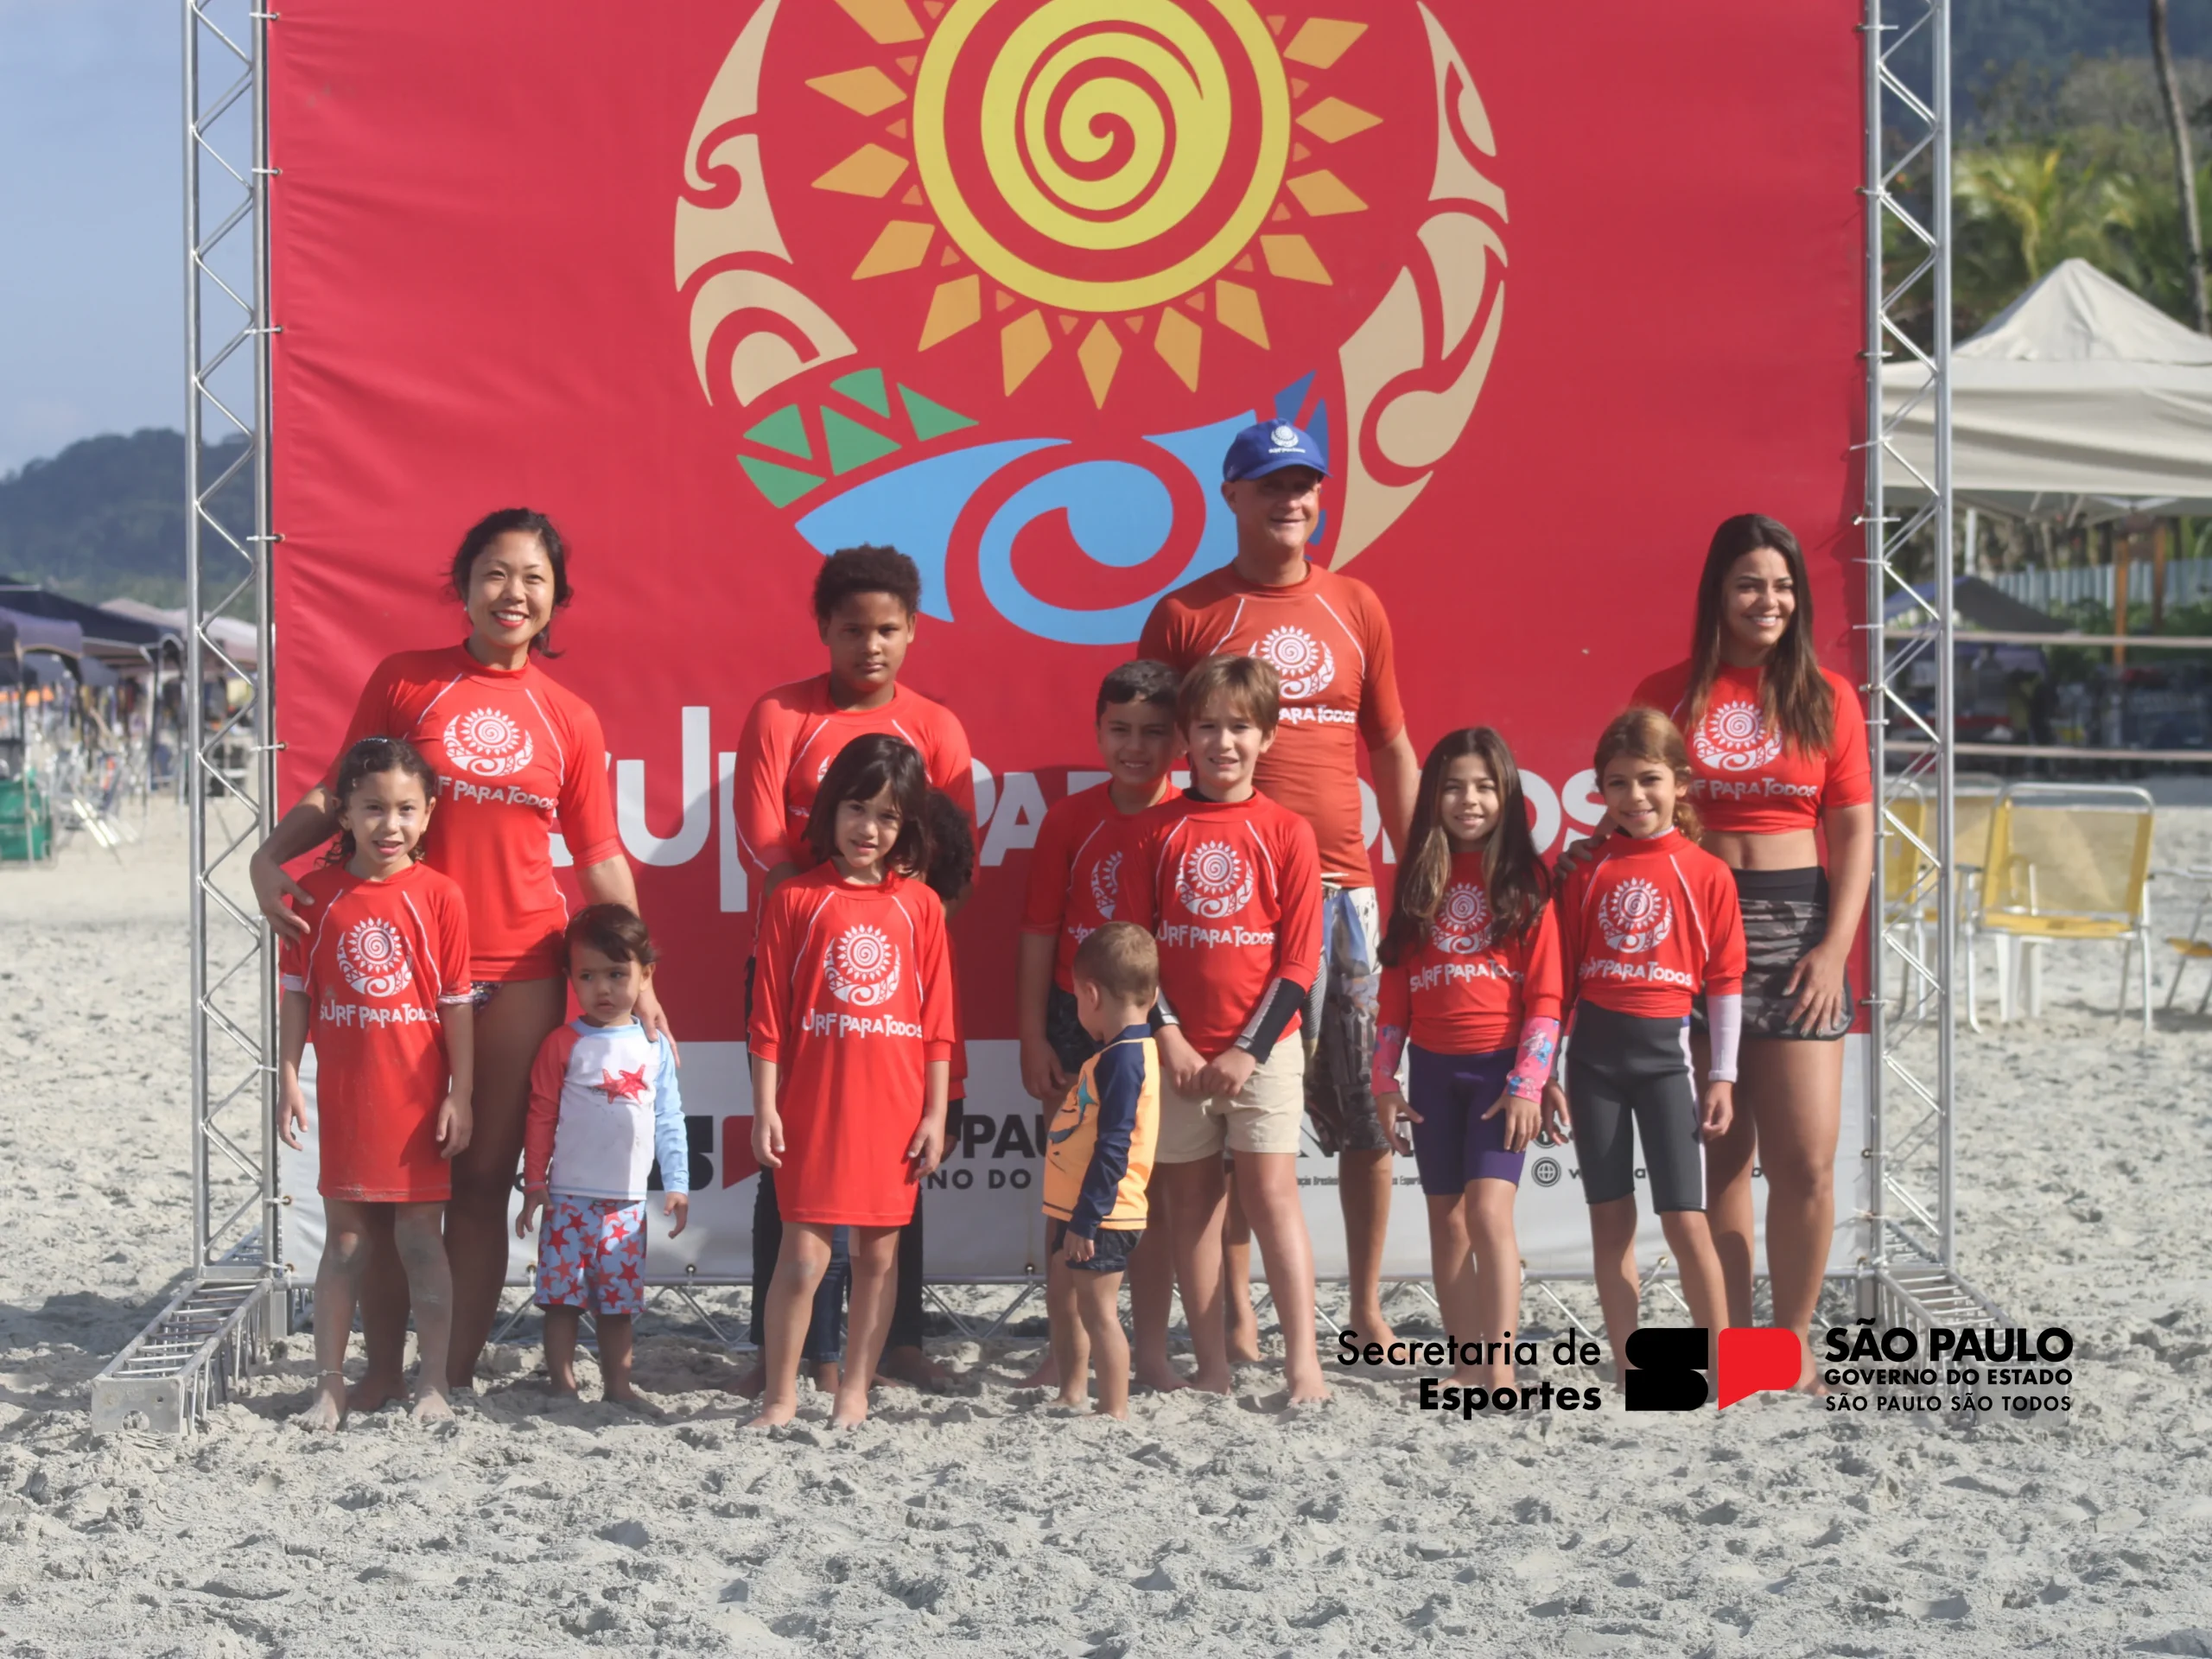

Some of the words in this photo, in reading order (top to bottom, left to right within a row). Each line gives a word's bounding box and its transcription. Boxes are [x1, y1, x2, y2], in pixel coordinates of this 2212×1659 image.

[1279, 707, 1316, 725] ARA
[454, 779, 504, 804] PARA
[1710, 780, 1761, 801] PARA
[1761, 778, 1818, 797] TODOS
[1157, 919, 1188, 948] URF
[1190, 926, 1234, 949] PARA
[1232, 925, 1275, 947] TODOS
[1444, 963, 1490, 987] PARA
[1601, 959, 1645, 982] PARA
[1647, 961, 1693, 987] TODOS
[359, 1006, 404, 1029] PARA
[802, 1007, 837, 1038] URF
[839, 1014, 884, 1039] PARA
[883, 1014, 923, 1039] TODOS
[988, 1168, 1032, 1190] DO
